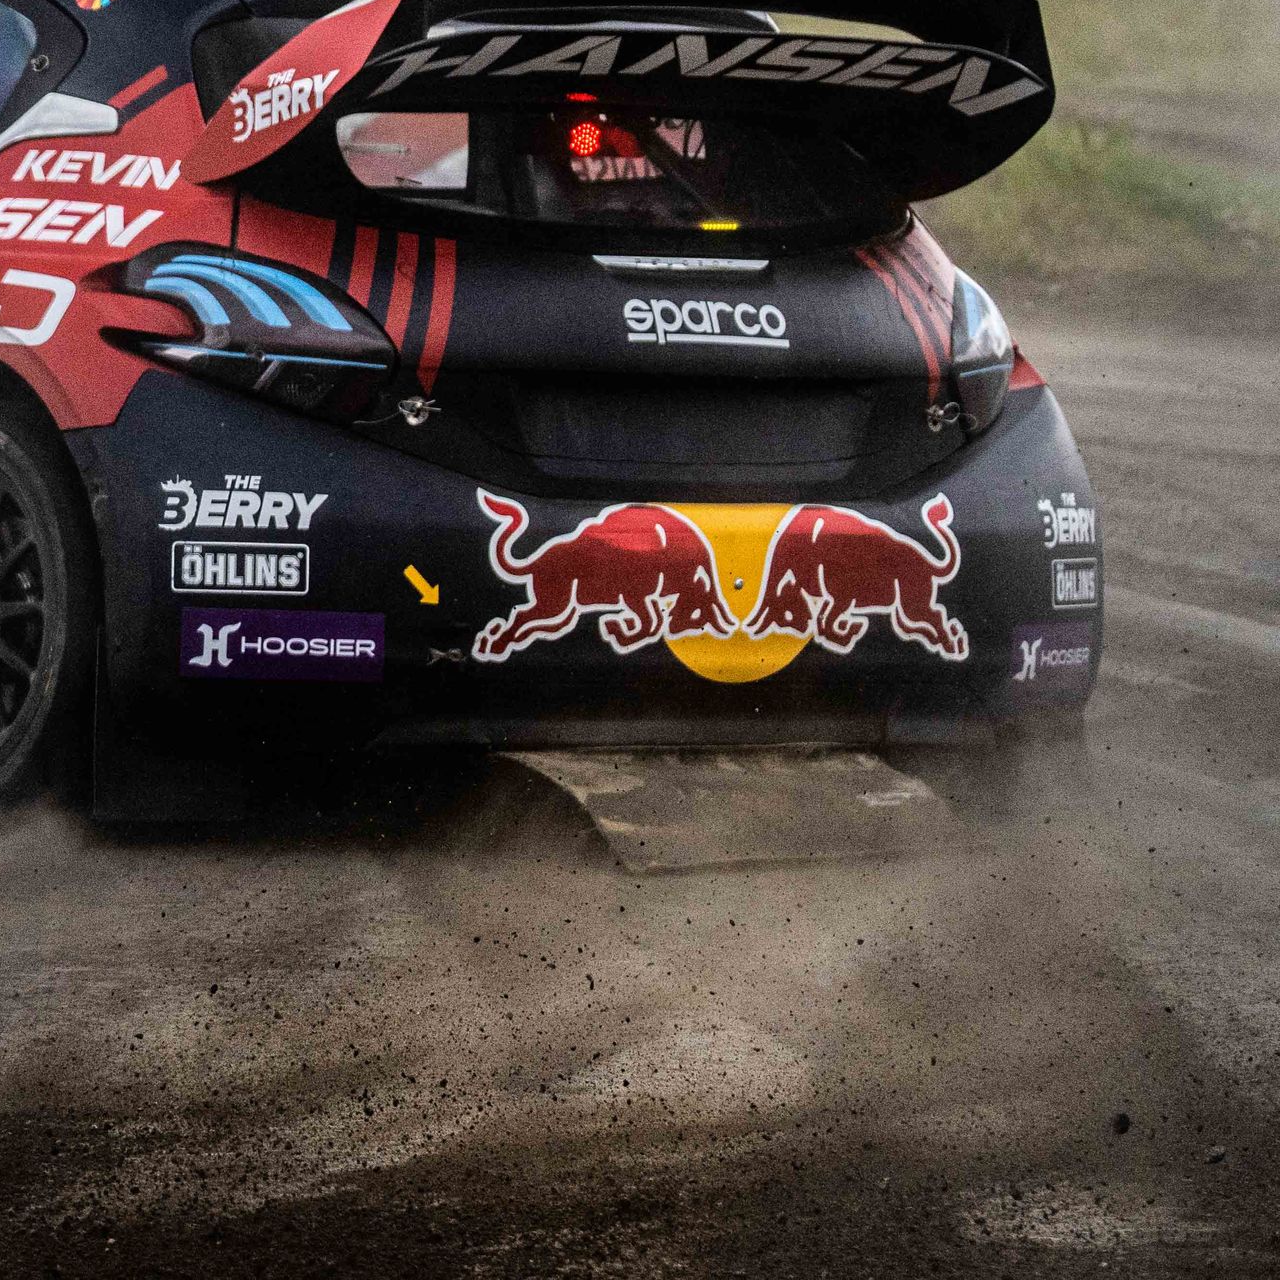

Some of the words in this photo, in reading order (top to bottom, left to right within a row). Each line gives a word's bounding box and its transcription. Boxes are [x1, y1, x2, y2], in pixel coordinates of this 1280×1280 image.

[267, 68, 296, 88] THE
[368, 33, 1047, 117] HANSEN
[228, 68, 340, 143] BERRY
[11, 149, 182, 191] KEVIN
[623, 298, 787, 344] sparco
[158, 474, 329, 531] BERRY
[224, 474, 262, 490] THE
[181, 544, 302, 588] ÖHLINS
[241, 635, 376, 658] HOOSIER
